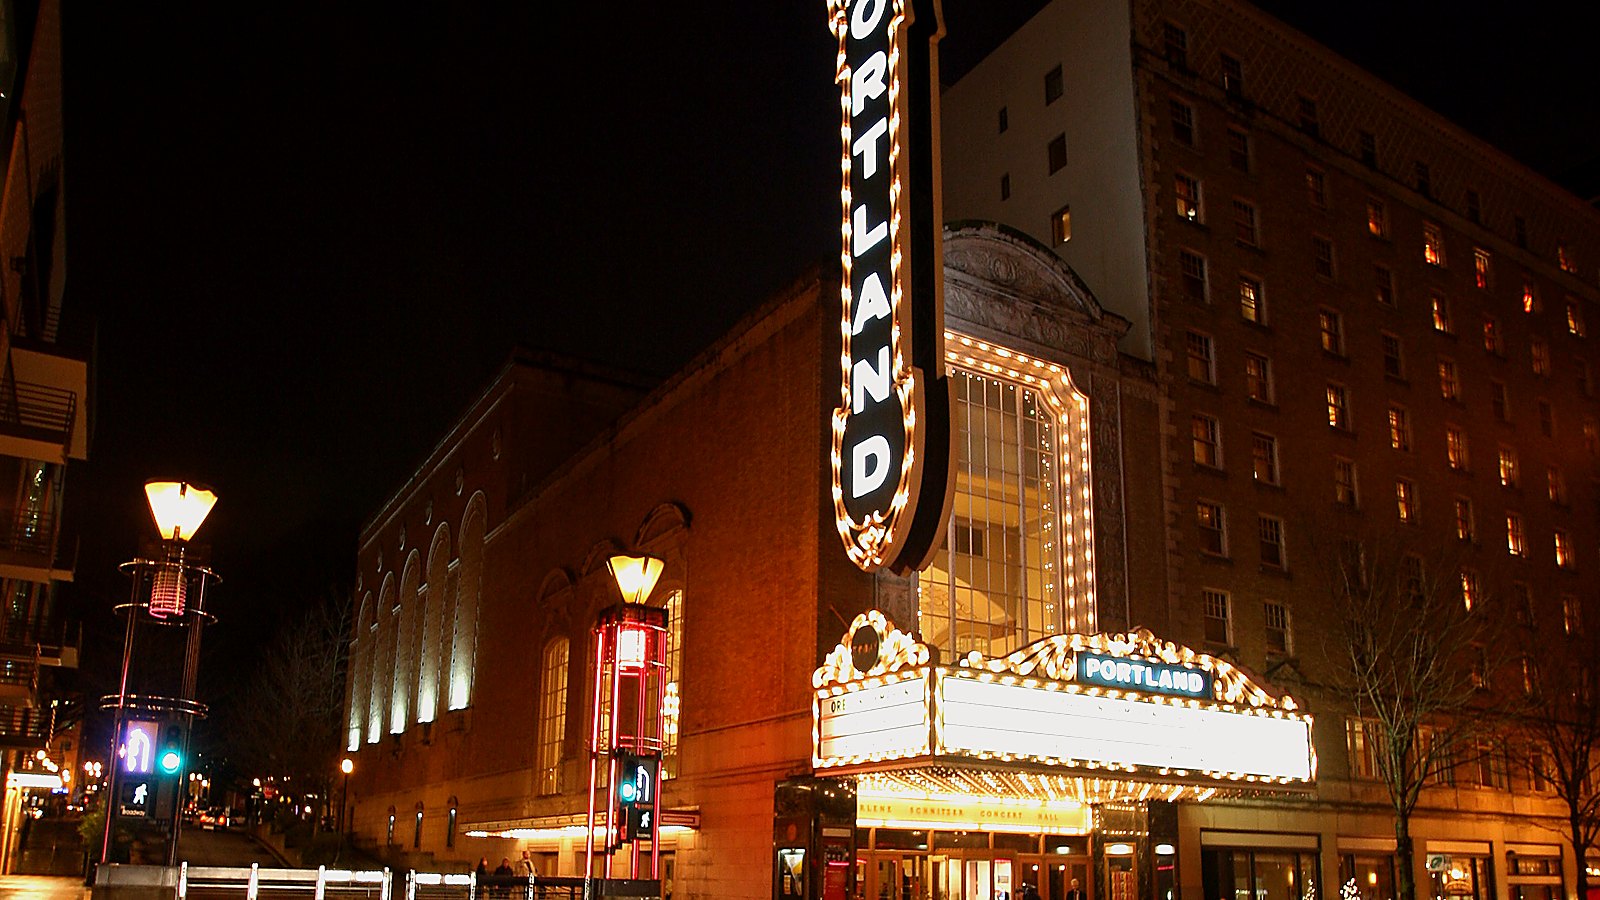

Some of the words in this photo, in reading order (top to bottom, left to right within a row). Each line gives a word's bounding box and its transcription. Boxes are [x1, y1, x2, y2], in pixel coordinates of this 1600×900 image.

[1086, 658, 1204, 693] PORTLAND
[910, 806, 964, 816] SCHNITZER
[980, 810, 1023, 819] CONCERT
[1038, 813, 1059, 821] HALL
